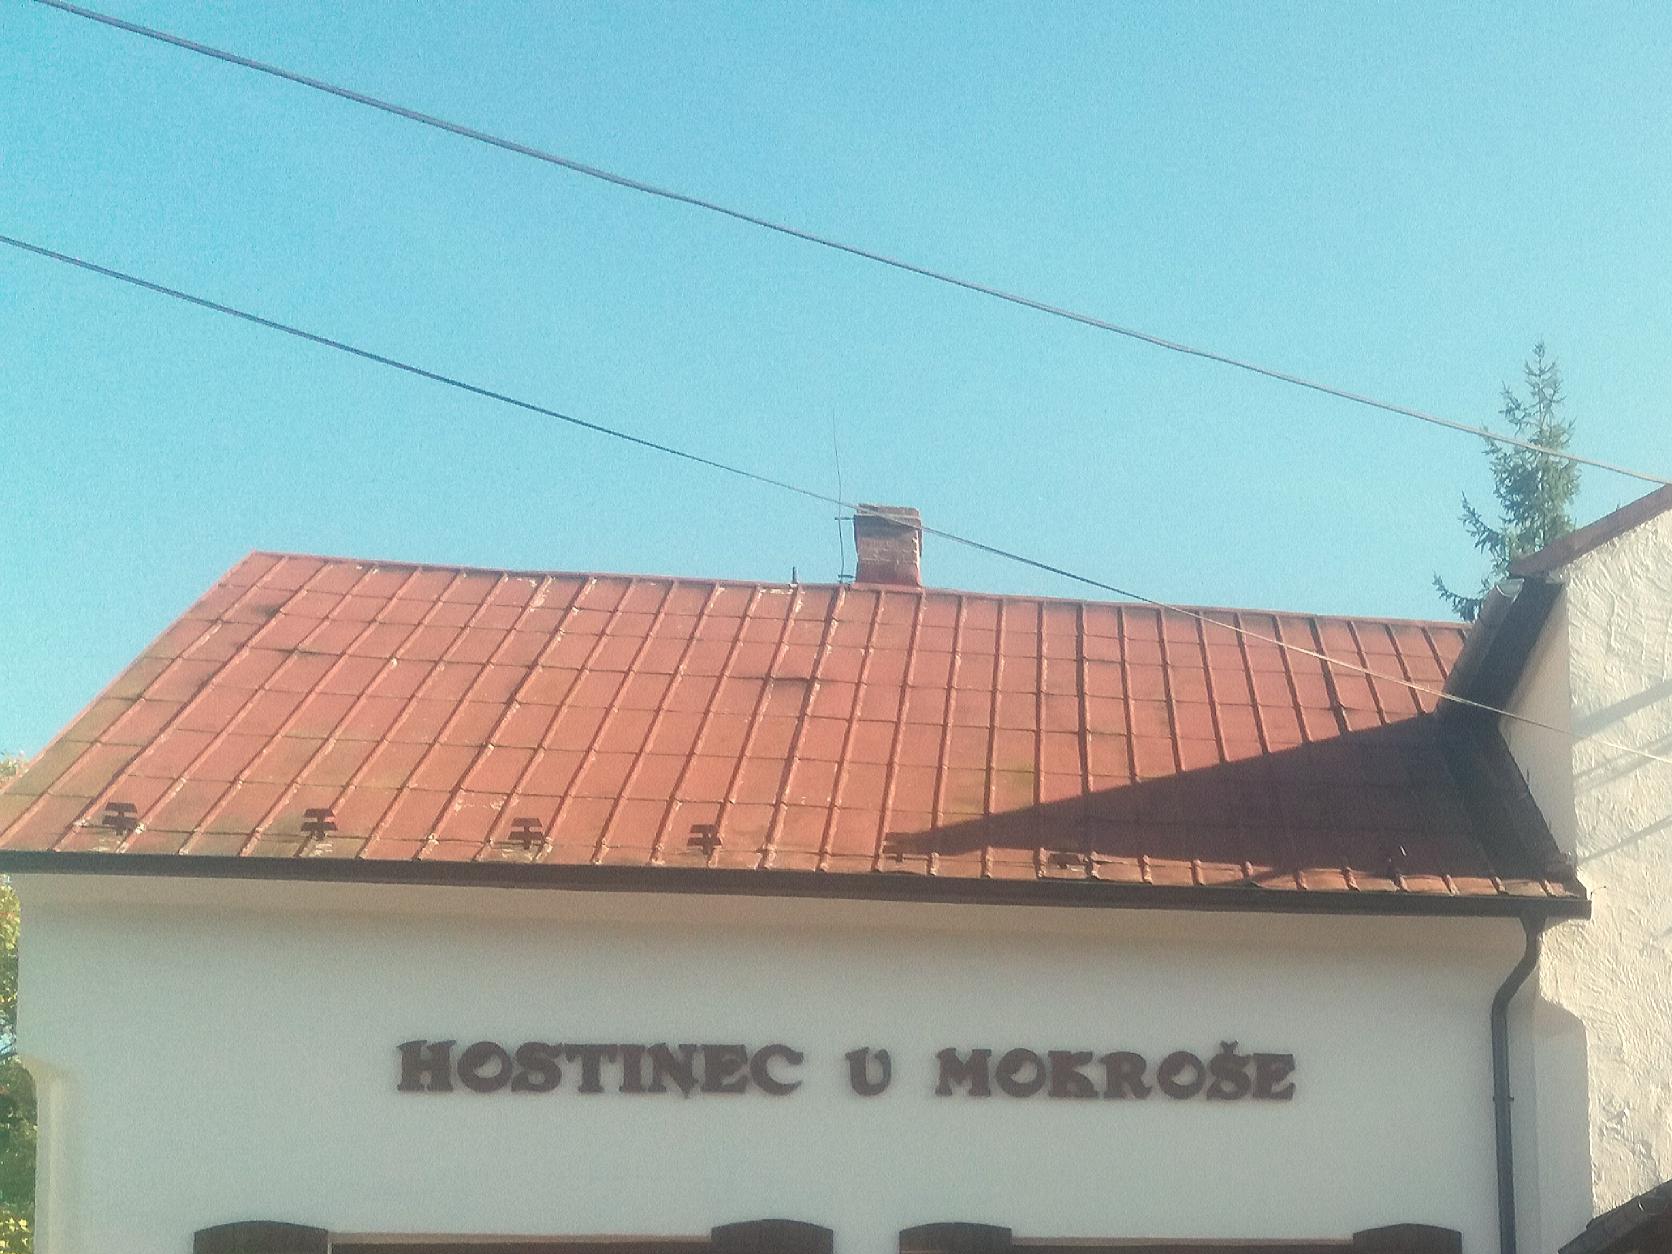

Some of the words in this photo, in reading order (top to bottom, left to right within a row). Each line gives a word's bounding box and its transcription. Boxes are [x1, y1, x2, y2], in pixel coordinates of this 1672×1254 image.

[396, 1039, 804, 1099] HOSTINEC
[845, 1047, 892, 1097] U
[935, 1040, 1297, 1101] MOKROŠE
